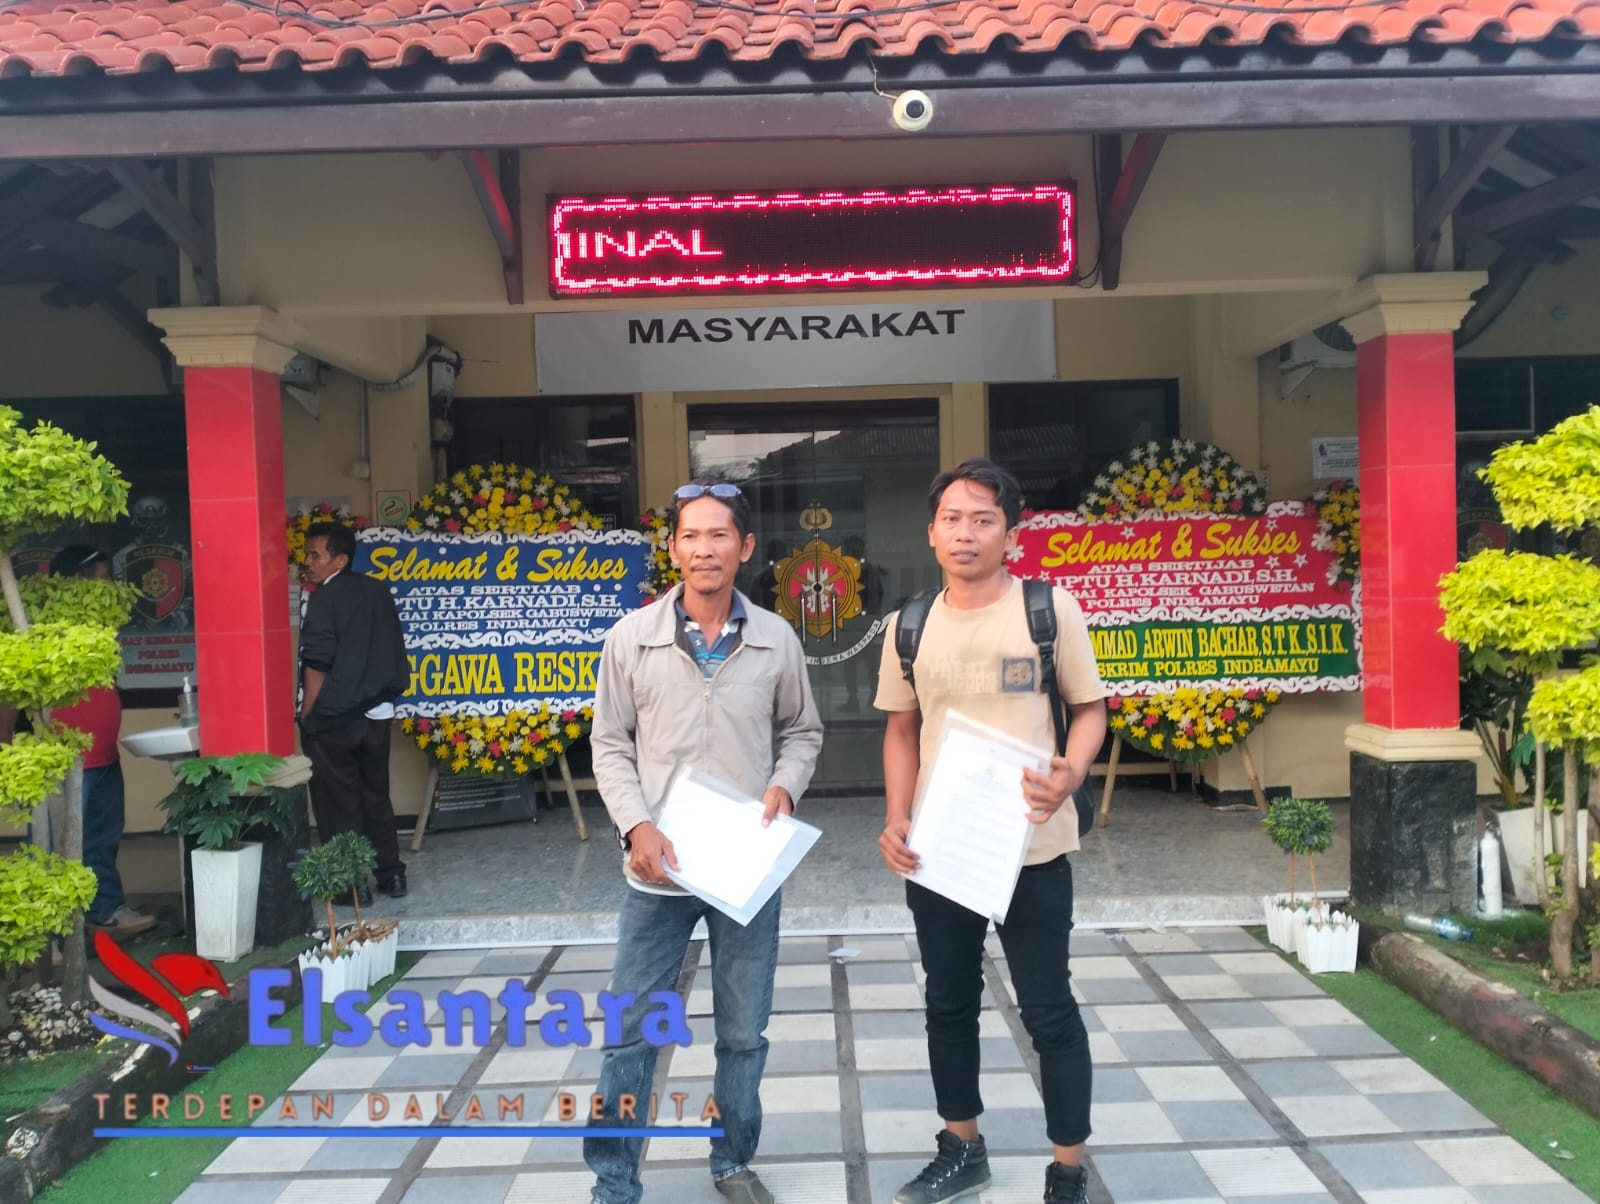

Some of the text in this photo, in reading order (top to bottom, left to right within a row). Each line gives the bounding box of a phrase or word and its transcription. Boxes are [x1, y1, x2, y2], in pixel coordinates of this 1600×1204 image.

[628, 309, 965, 344] MASYARAKAT
[1041, 520, 1300, 567] Selamat & Sukses
[365, 545, 627, 582] Selamat & Sukses
[1087, 559, 1255, 574] ATAS SERTIJAB
[1054, 573, 1112, 589] IPTU
[406, 584, 581, 596] ATAS SERTIJAB
[1104, 585, 1192, 598] KAPOLSEK
[1199, 582, 1316, 596] GABUSWETAN
[394, 597, 434, 611] TU
[1086, 594, 1261, 609] POLRES INDRAMAYU
[432, 609, 523, 621] KAPOLSEK
[408, 618, 590, 632] POLRES INDRAMAYU
[1143, 628, 1194, 658] ARWIN
[513, 651, 603, 692] RESK
[1154, 659, 1218, 677] POLRES
[1223, 657, 1319, 675] INDRAMAYU
